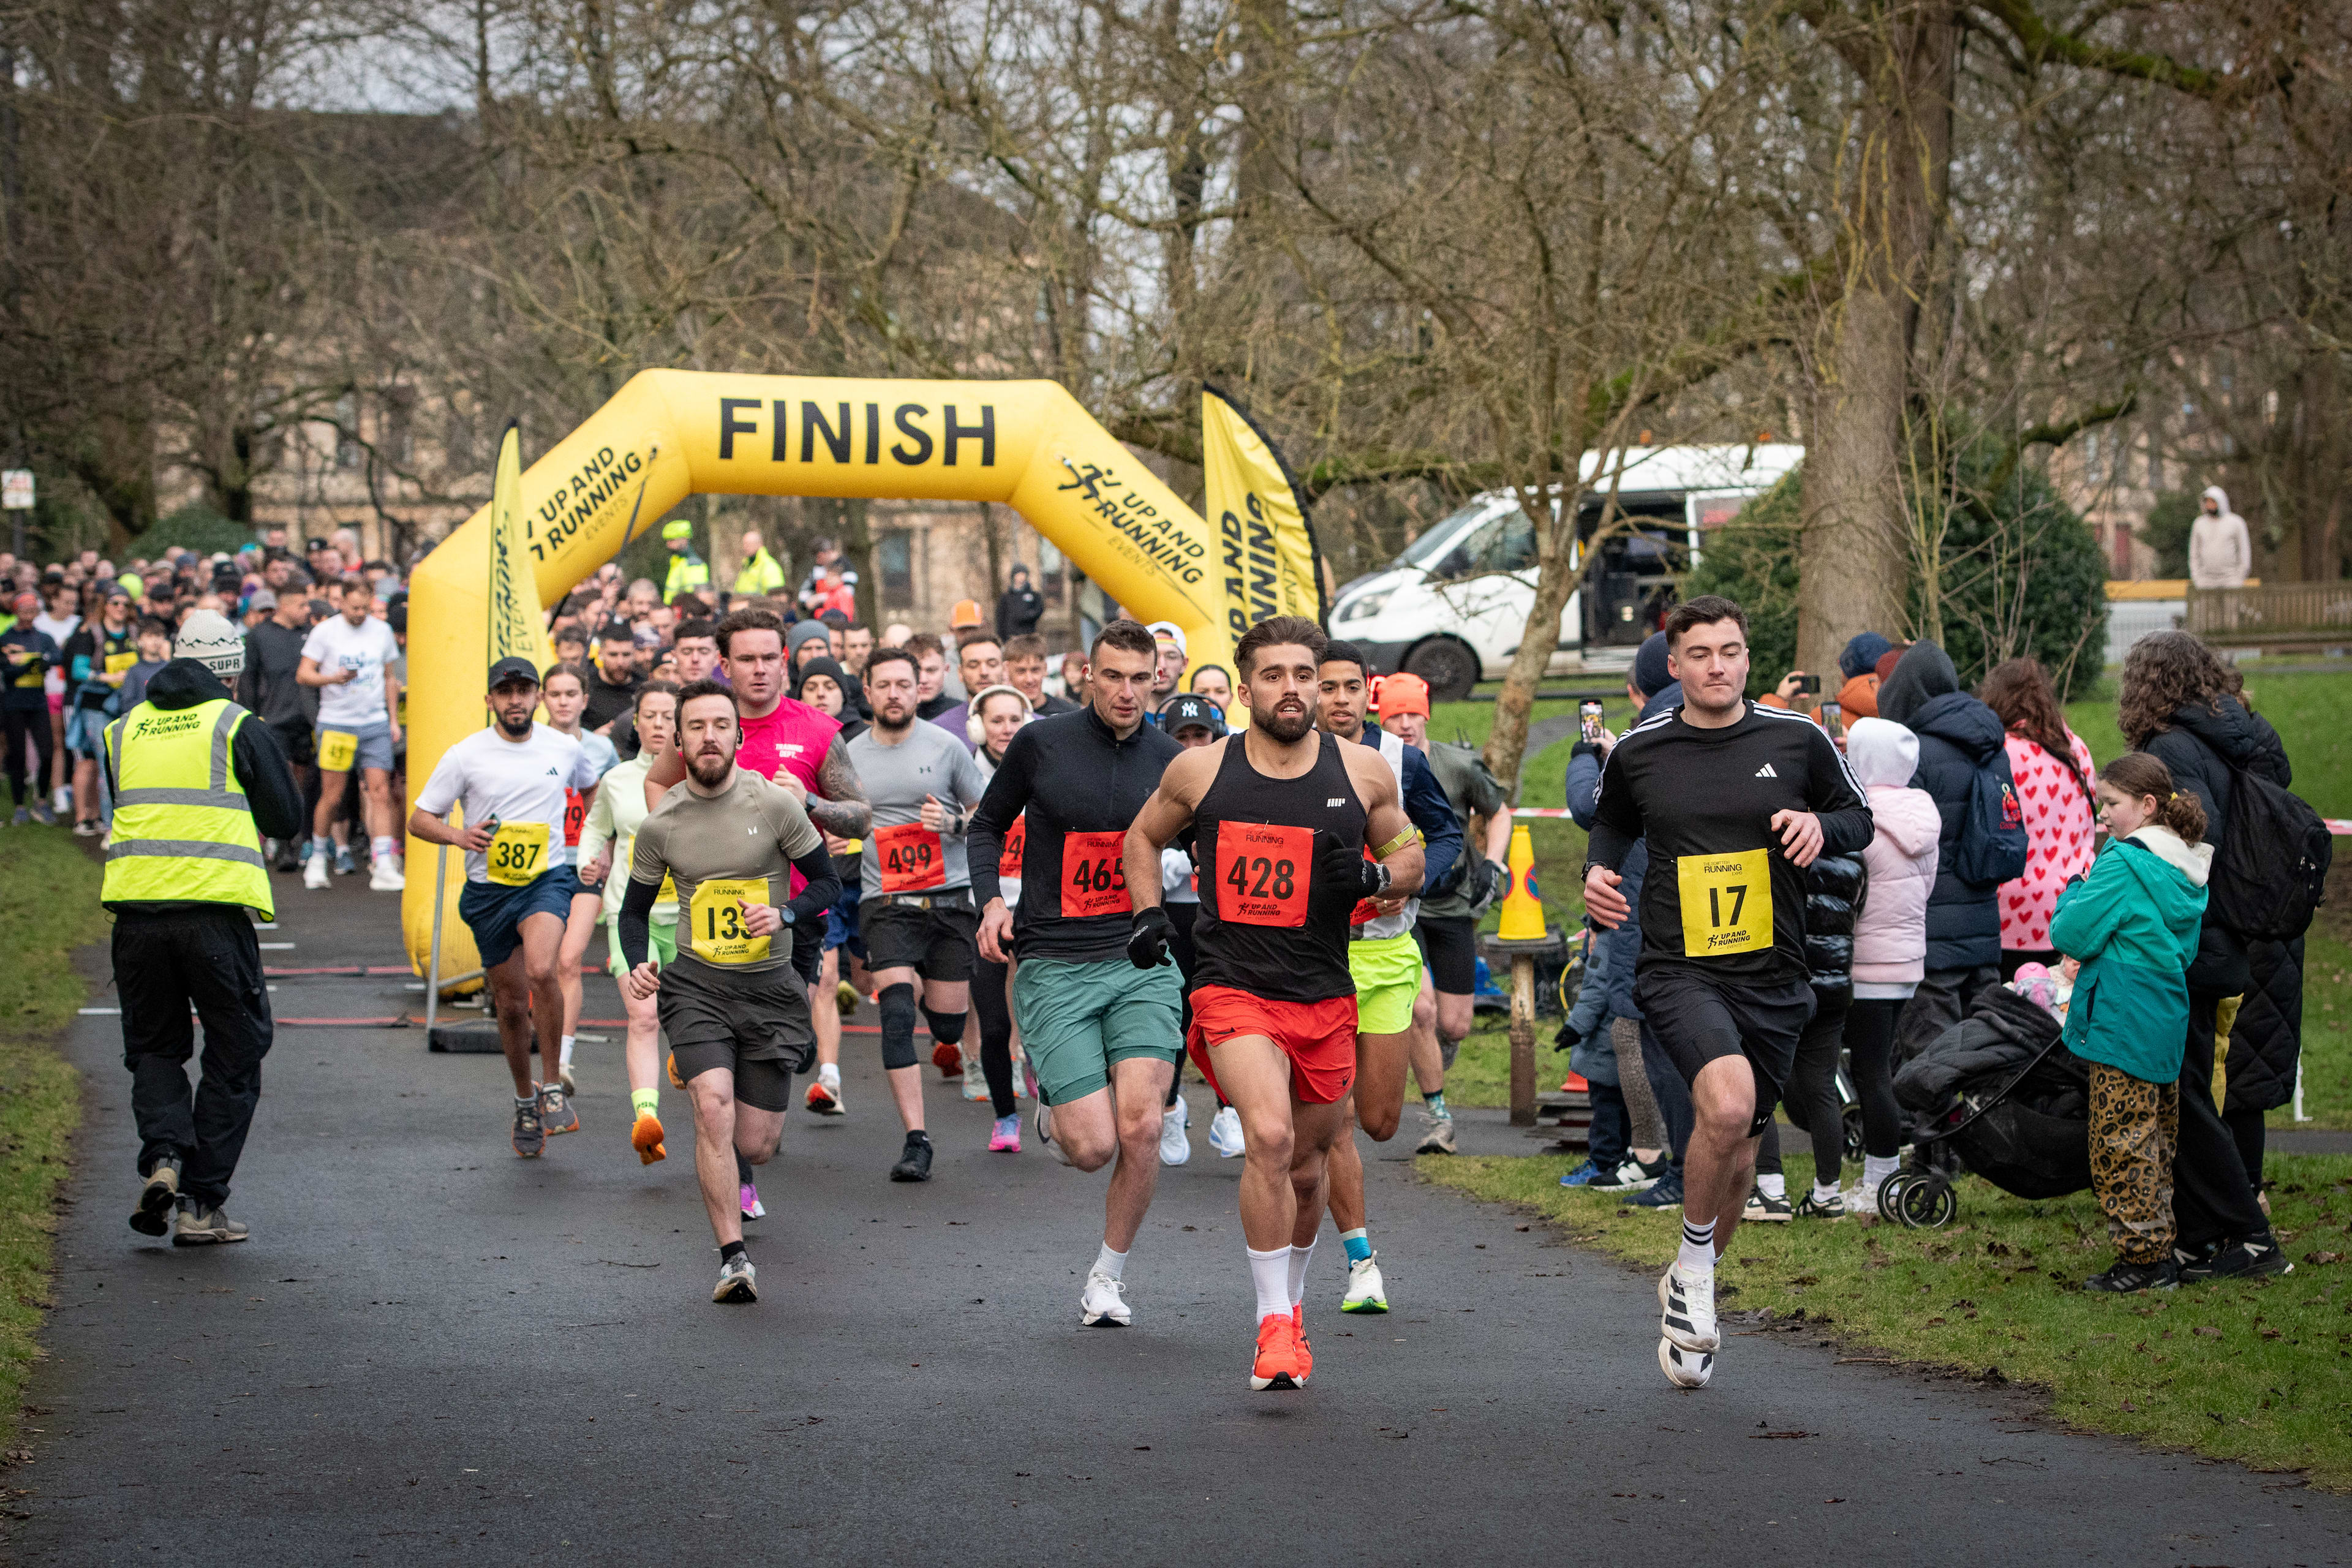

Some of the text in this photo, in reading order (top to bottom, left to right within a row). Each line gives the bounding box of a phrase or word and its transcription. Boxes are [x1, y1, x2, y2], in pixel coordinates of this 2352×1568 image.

[718, 397, 995, 467] FINISH
[539, 447, 614, 522] UP AND
[547, 452, 641, 550] RUNNING
[1123, 492, 1205, 557] UP AND
[1102, 500, 1204, 584] RUNNING
[1221, 511, 1248, 643] P AND
[209, 658, 239, 670] SUPR
[149, 722, 201, 736] RUNNING
[157, 714, 197, 726] UP AND
[775, 743, 804, 753] TRAINING
[1246, 834, 1284, 845] RUNNING
[496, 842, 541, 869] 387
[888, 843, 932, 873] 499
[1704, 864, 1742, 873] RUNNING
[1073, 858, 1126, 893] 465
[1227, 856, 1294, 900] 428
[1092, 899, 1120, 908] RUNNING
[1709, 884, 1747, 927] 17
[1718, 935, 1751, 946] RUNNING
